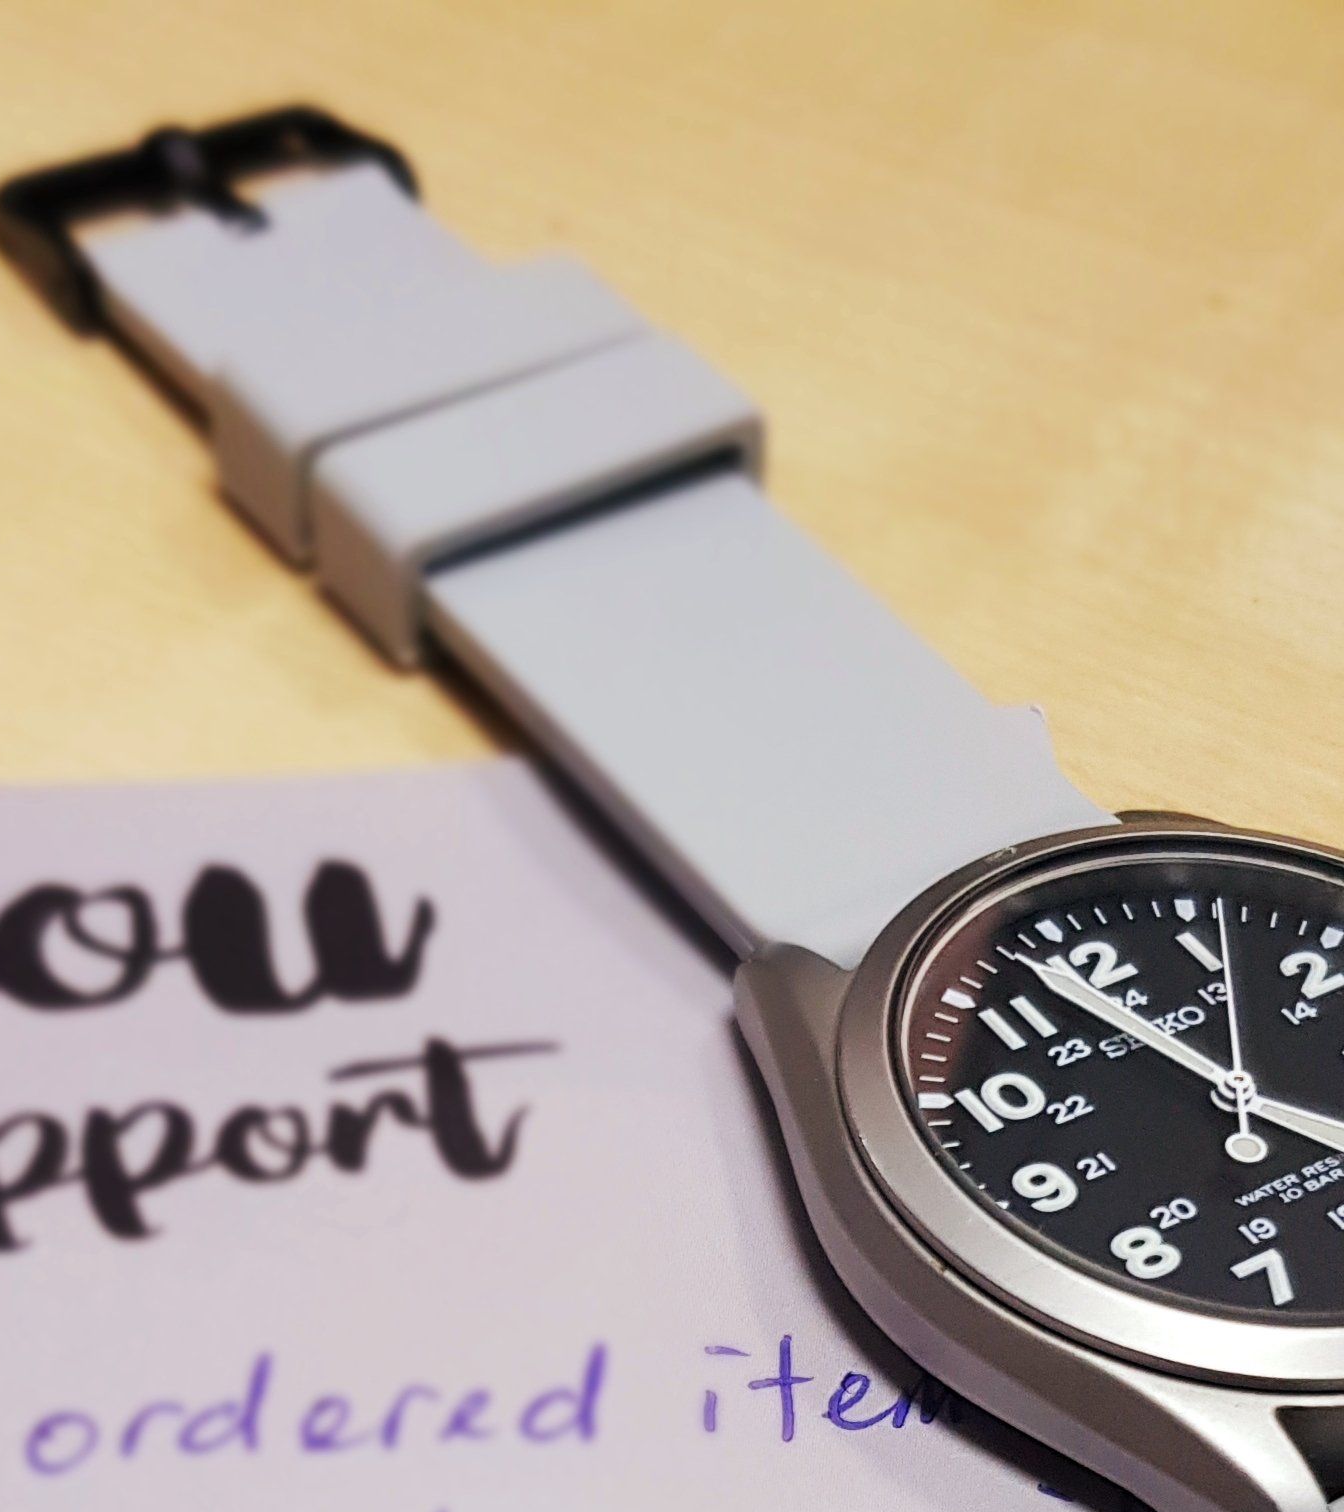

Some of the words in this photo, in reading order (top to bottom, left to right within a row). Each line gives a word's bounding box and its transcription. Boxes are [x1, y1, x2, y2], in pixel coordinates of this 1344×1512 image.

[1175, 932, 1223, 972] 1
[977, 995, 1058, 1050] 11
[1281, 1001, 1318, 1025] 14
[1048, 1038, 1092, 1067] 23
[955, 1072, 1046, 1132] 10
[1046, 1095, 1094, 1124] 22
[1076, 1152, 1116, 1180] 21
[1011, 1162, 1079, 1212] 9
[1234, 1173, 1300, 1207] WATER
[1150, 1198, 1197, 1229] 20
[1238, 1217, 1277, 1245] 19
[1110, 1225, 1182, 1279] 8
[1229, 1249, 1295, 1306] 7
[24, 1342, 608, 1476] ordered
